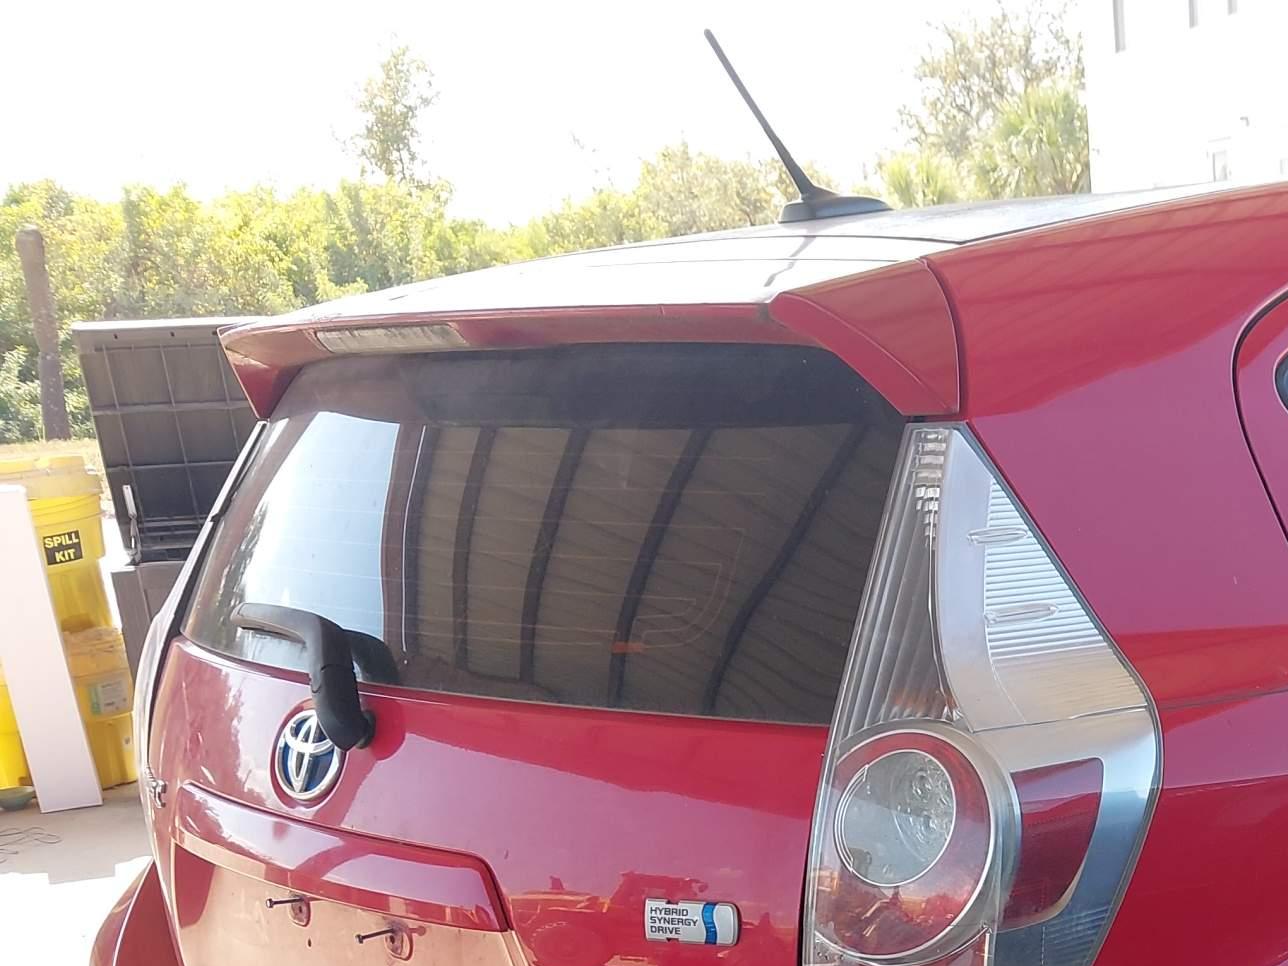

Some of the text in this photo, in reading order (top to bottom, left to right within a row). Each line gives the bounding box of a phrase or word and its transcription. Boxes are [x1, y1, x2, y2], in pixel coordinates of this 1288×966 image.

[44, 532, 79, 549] SPILL
[55, 548, 75, 562] KIT
[650, 906, 689, 917] HYBRID
[649, 916, 698, 927] SYNERGY
[650, 925, 681, 935] DRIVE
